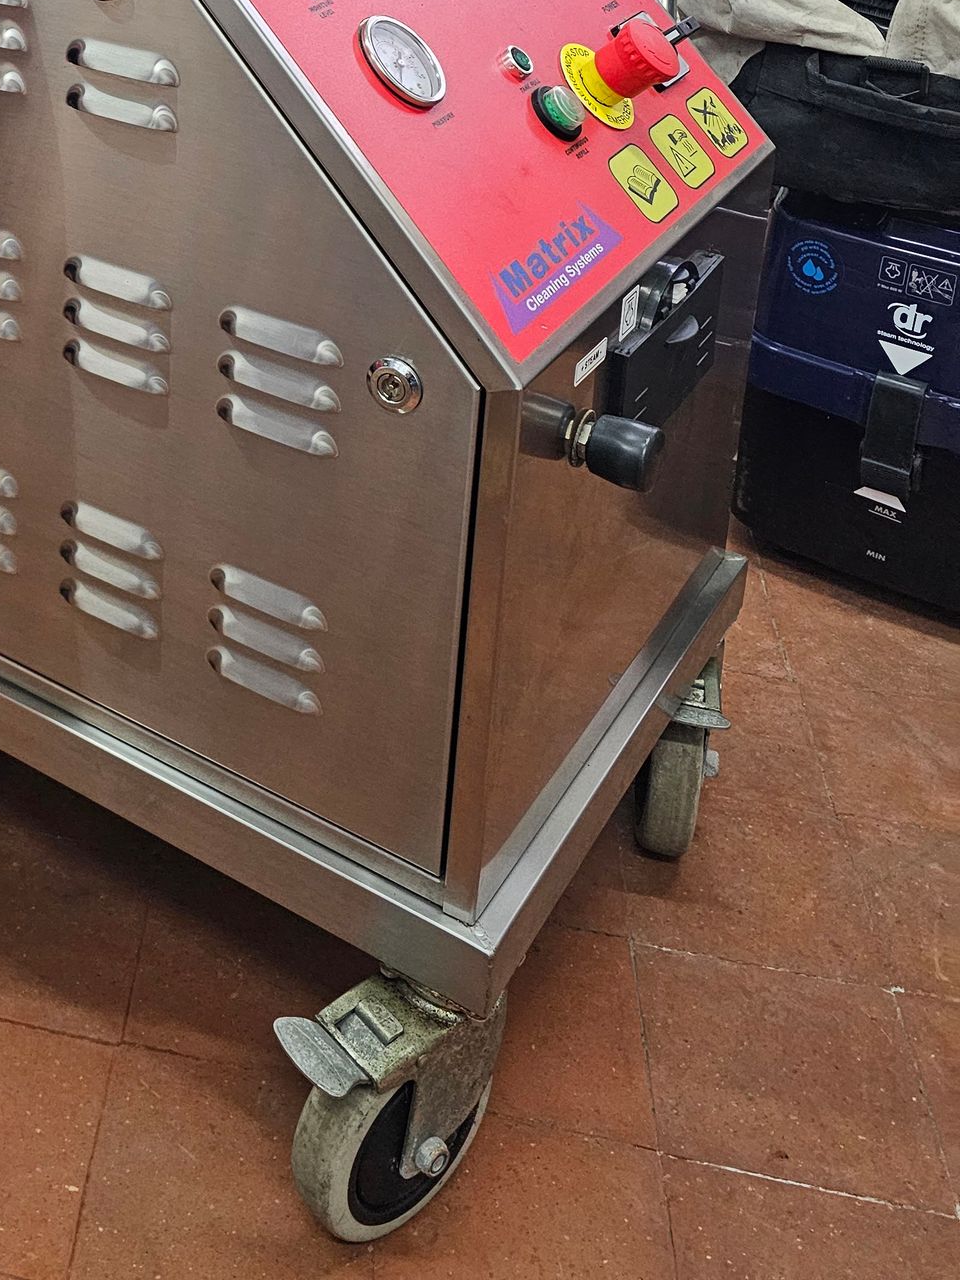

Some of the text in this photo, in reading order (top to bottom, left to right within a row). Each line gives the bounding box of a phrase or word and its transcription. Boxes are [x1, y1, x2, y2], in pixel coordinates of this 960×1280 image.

[319, 9, 334, 19] LEVEL
[601, 0, 620, 13] POWER
[570, 47, 589, 57] STOP
[432, 111, 455, 128] PRESSURE
[565, 136, 589, 156] CONTINUOUS
[498, 214, 595, 298] Matrix
[526, 241, 604, 312] Cleaning Systems
[893, 304, 933, 333] dr
[877, 329, 935, 352] steam technology
[874, 504, 897, 519] MAX
[866, 549, 886, 562] MIN
